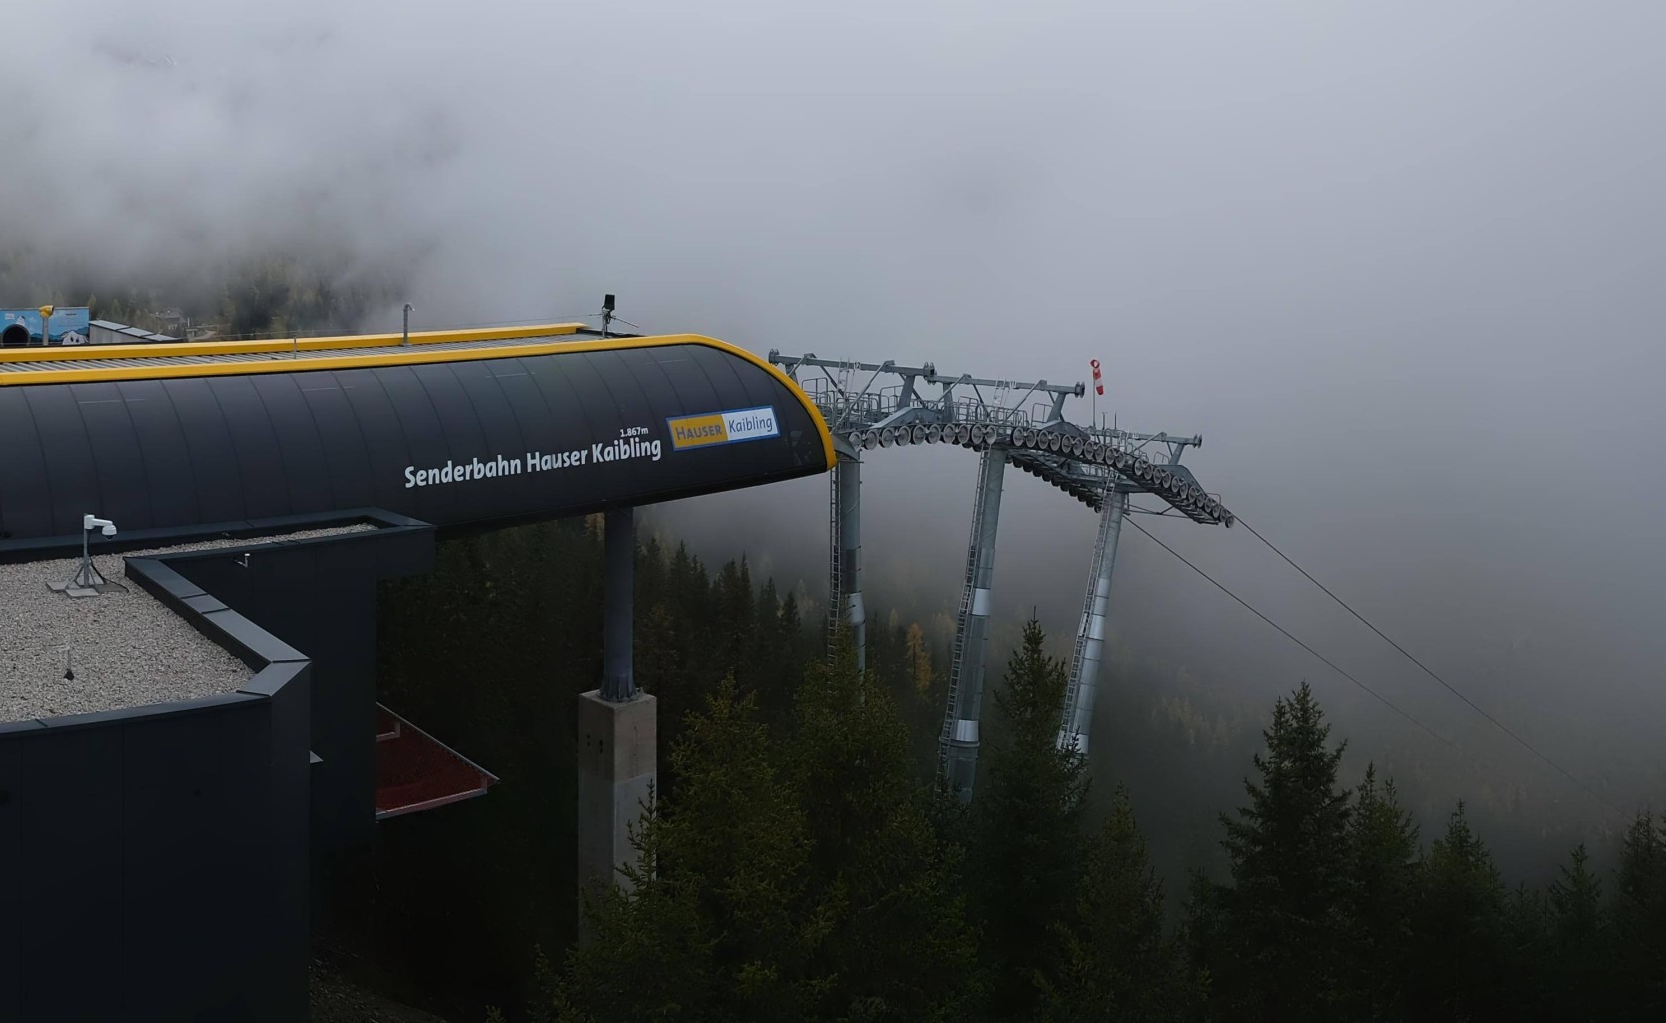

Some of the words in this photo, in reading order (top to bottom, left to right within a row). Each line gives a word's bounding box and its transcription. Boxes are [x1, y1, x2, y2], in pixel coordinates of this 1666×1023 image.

[620, 426, 649, 437] 1.867m
[675, 424, 723, 441] HAUSER
[728, 416, 773, 433] Kaibling
[405, 454, 521, 488] Senderbahn
[526, 448, 588, 473] Hauser
[592, 438, 661, 461] Kaibling
